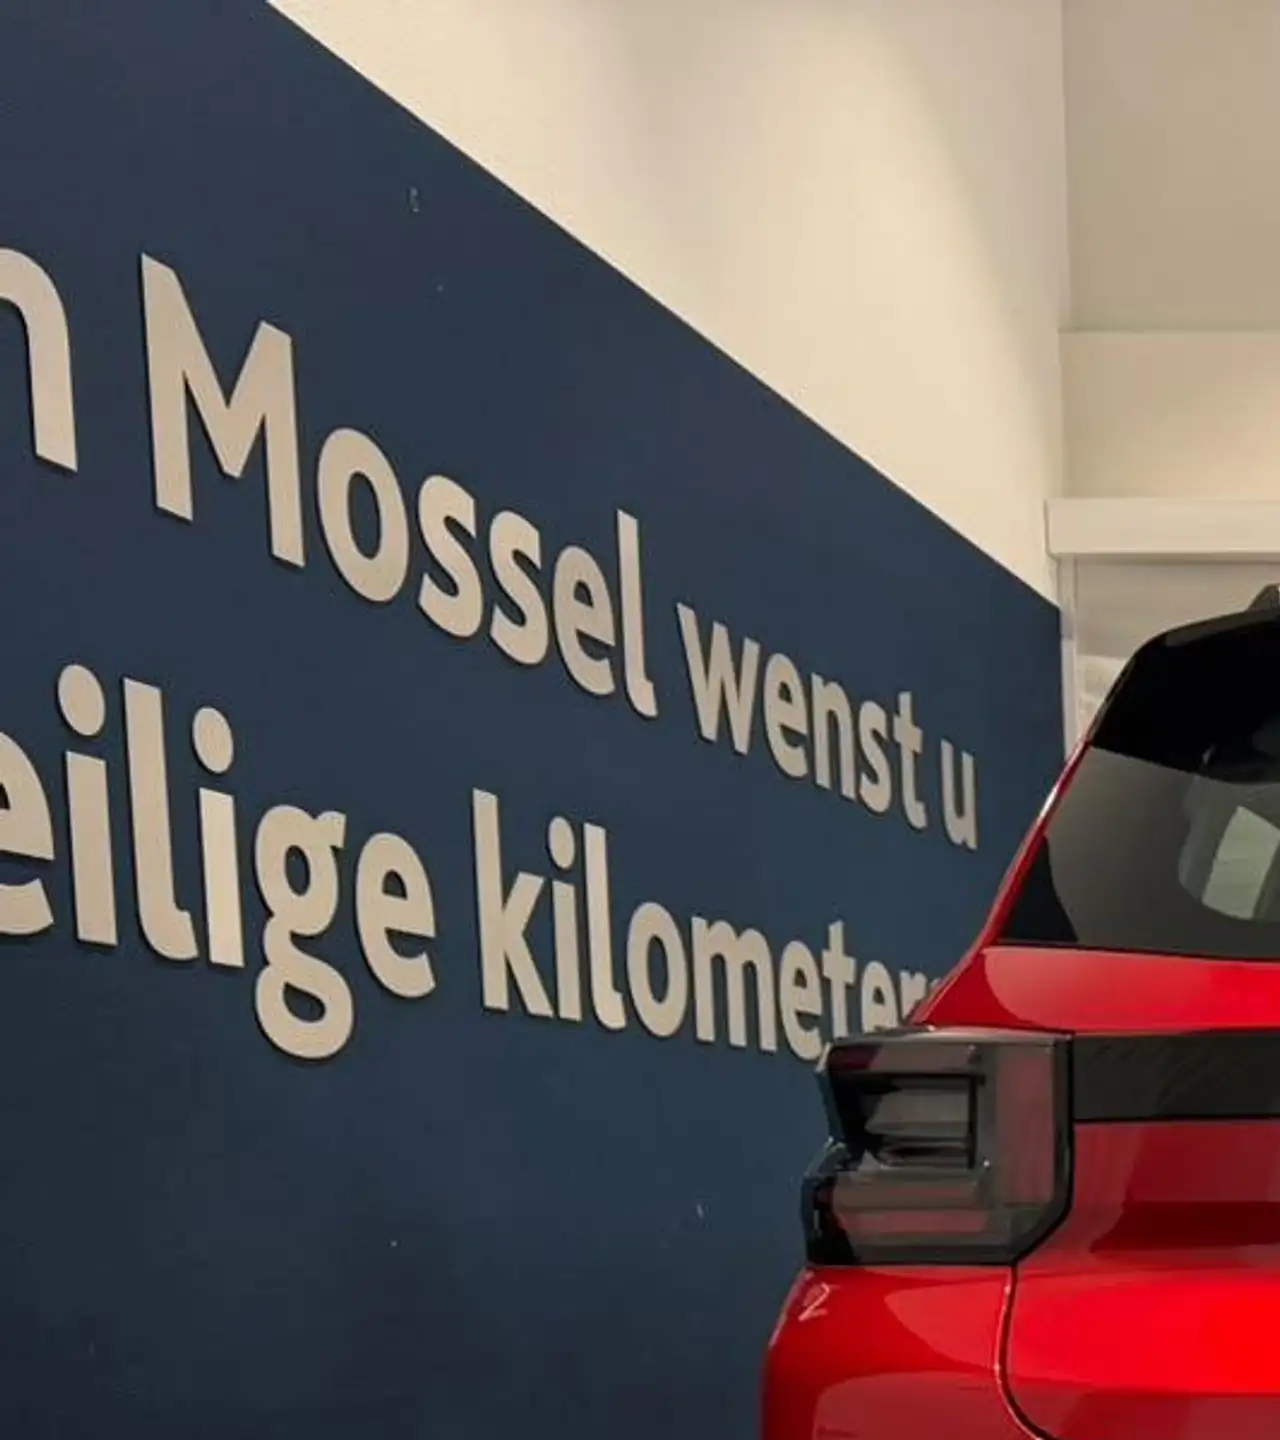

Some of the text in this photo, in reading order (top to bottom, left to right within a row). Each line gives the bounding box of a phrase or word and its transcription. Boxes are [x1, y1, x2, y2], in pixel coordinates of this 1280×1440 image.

[140, 252, 658, 718] Mossel
[676, 601, 928, 830] wenst
[940, 738, 978, 851] u
[472, 786, 942, 1061] kilometer
